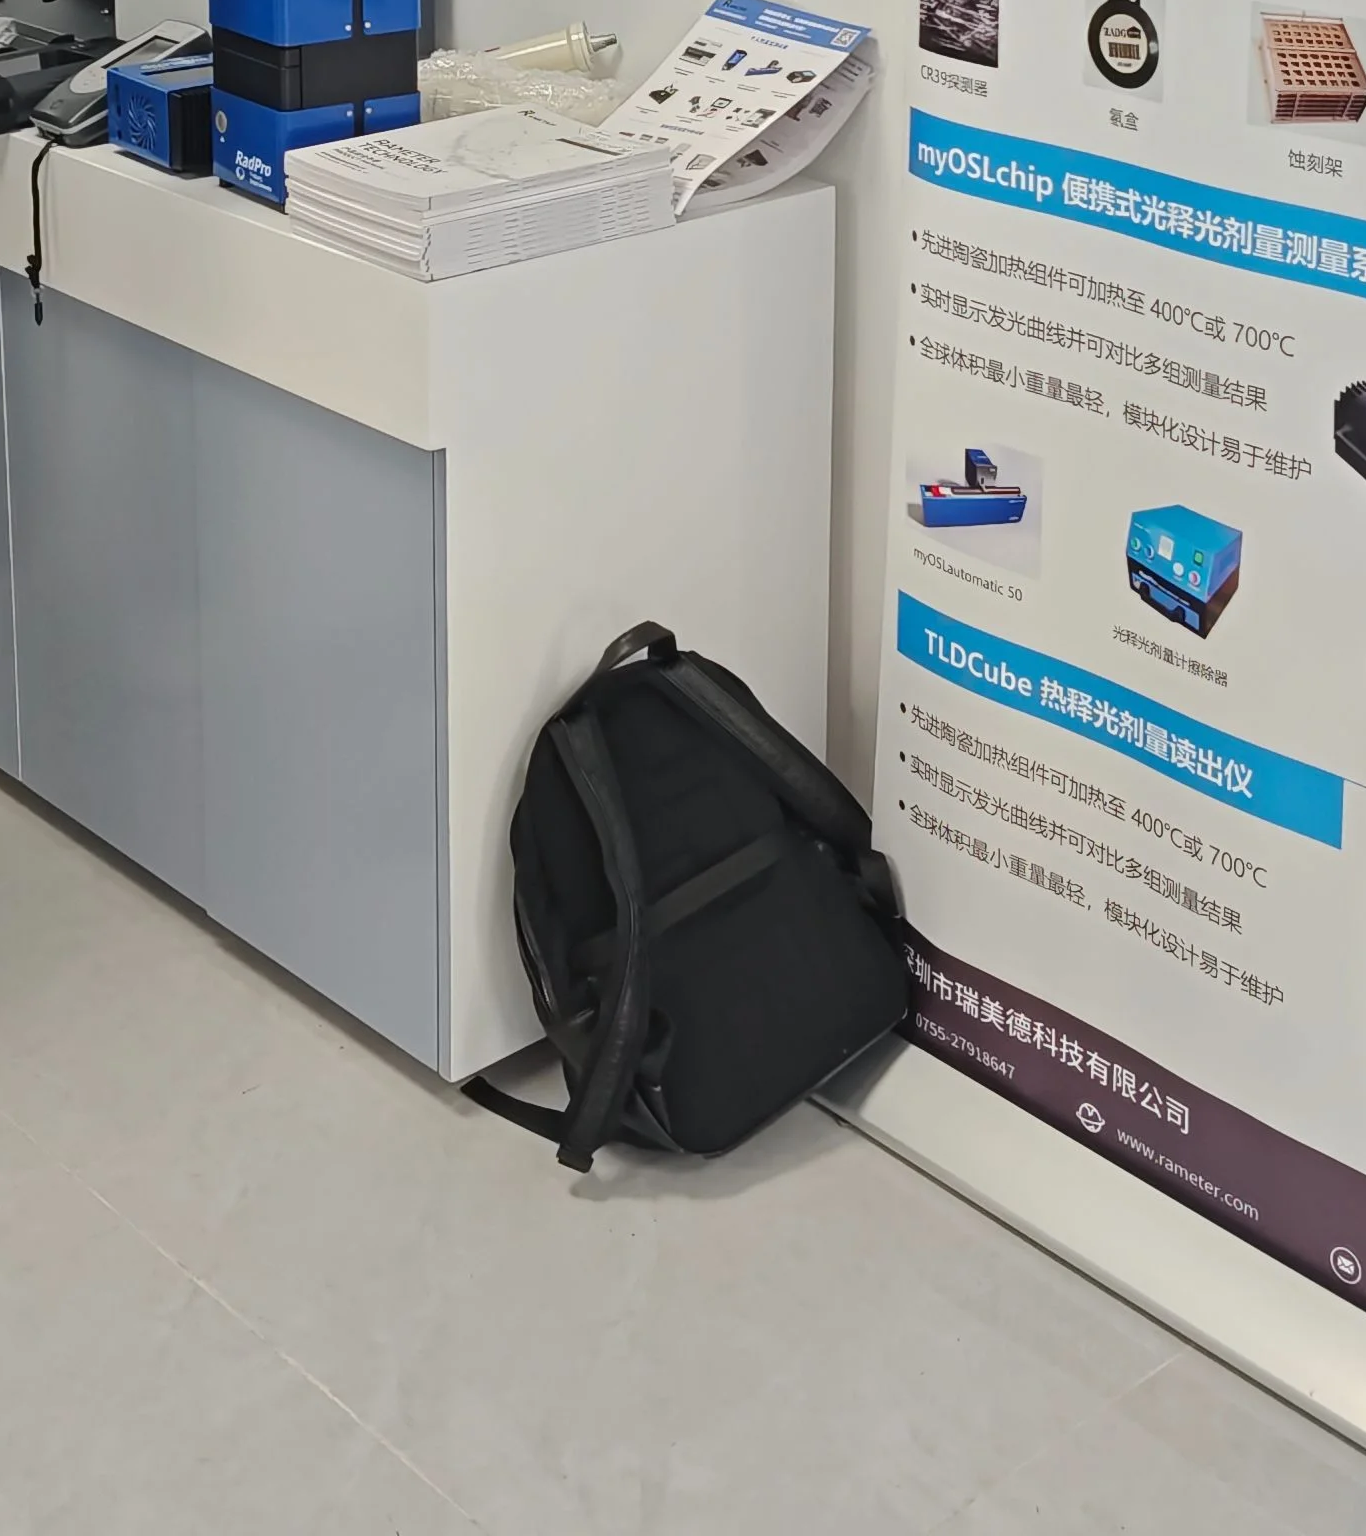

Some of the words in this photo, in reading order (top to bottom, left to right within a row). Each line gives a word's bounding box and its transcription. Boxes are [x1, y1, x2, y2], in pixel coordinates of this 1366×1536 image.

[920, 64, 989, 98] CR39探测器
[235, 149, 272, 177] RadPro
[358, 142, 449, 174] TECHNOLOGY
[374, 139, 441, 164] RAMETER
[917, 140, 1054, 202] myOSLchip
[1287, 148, 1344, 178] 蚀刻架
[920, 228, 1145, 317] 先进陶瓷加热组件可加热至
[920, 281, 1268, 414] 实时显示发光曲线并可对比多组测量结果
[920, 334, 1313, 481] 全球体积最小重量最轻，模块化设计易于维护
[912, 546, 1005, 598] myOSLautomatic
[1006, 584, 1023, 603] 50
[1112, 625, 1229, 689] 光释光剂量计擦除器
[923, 625, 1034, 700] TLDCube
[1038, 675, 1255, 800] 热释光剂量读出仪
[910, 702, 1127, 822] 先进陶瓷加热组件可加热至
[910, 751, 1244, 936] 实时显示发光曲线并可对比多组测量结果
[908, 802, 1286, 1007] 全球体积最小重量最轻，模块化设计易于维护
[903, 942, 1192, 1137] 深圳市瑞美德科技有限公司
[915, 1011, 1016, 1080] 0755-27918647
[1116, 1127, 1260, 1223] www.rameter.com
